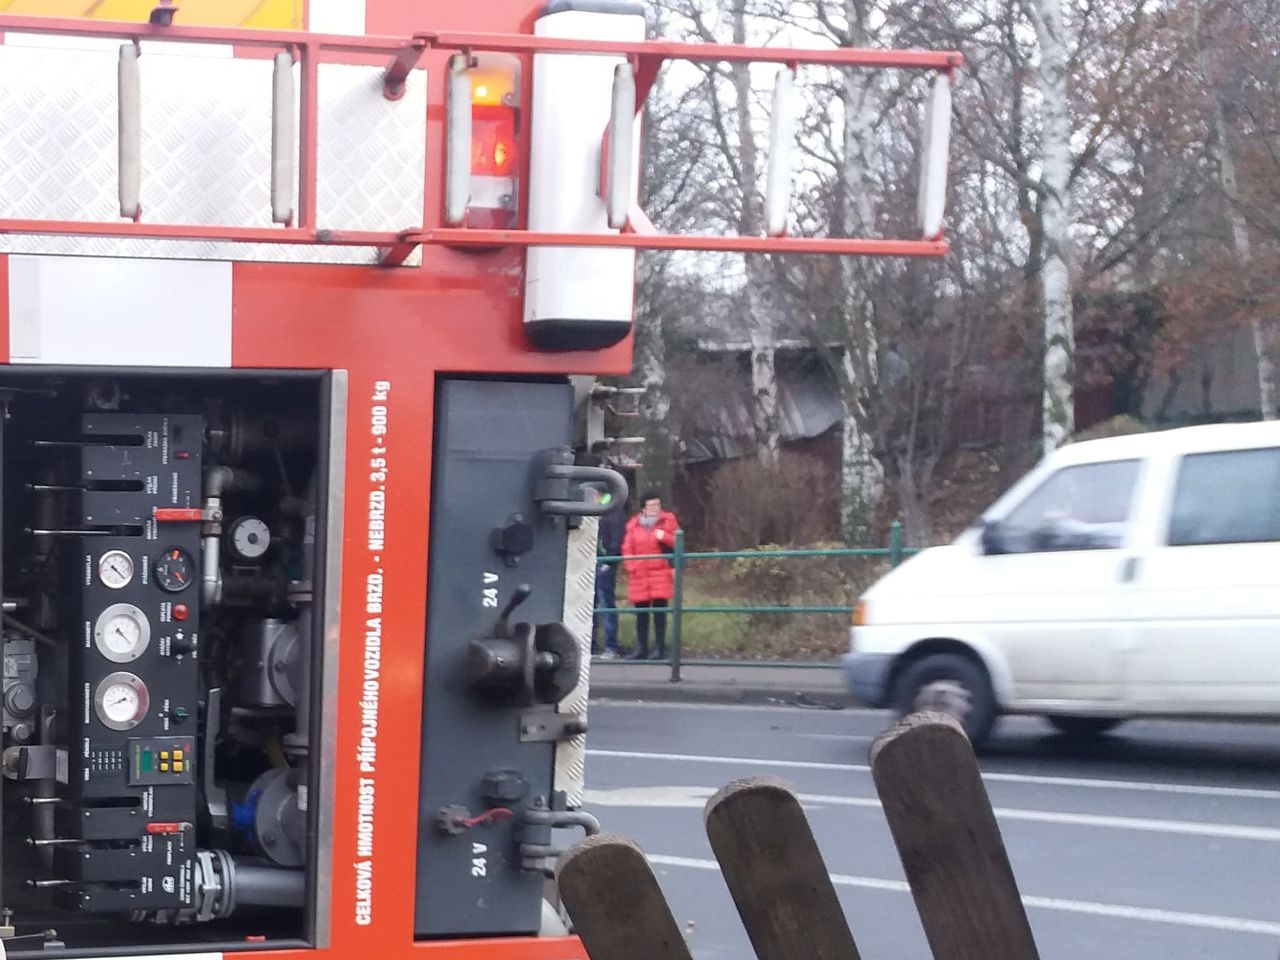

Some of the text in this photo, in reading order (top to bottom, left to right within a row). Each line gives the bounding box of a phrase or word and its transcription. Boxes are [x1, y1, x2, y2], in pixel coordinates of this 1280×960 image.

[371, 381, 390, 400] kg
[371, 406, 387, 435] 900
[370, 458, 388, 482] 3,5
[367, 485, 385, 550] NEBRZD.
[365, 568, 383, 613] BRZD.
[483, 572, 498, 607] 24 V
[364, 618, 381, 679] VOZIDLA
[356, 680, 379, 772] PŘÍPOJNÉHO
[357, 778, 375, 856] HMOTNOST
[472, 843, 487, 877] 24 V
[354, 861, 372, 925] CELKOVÁ
